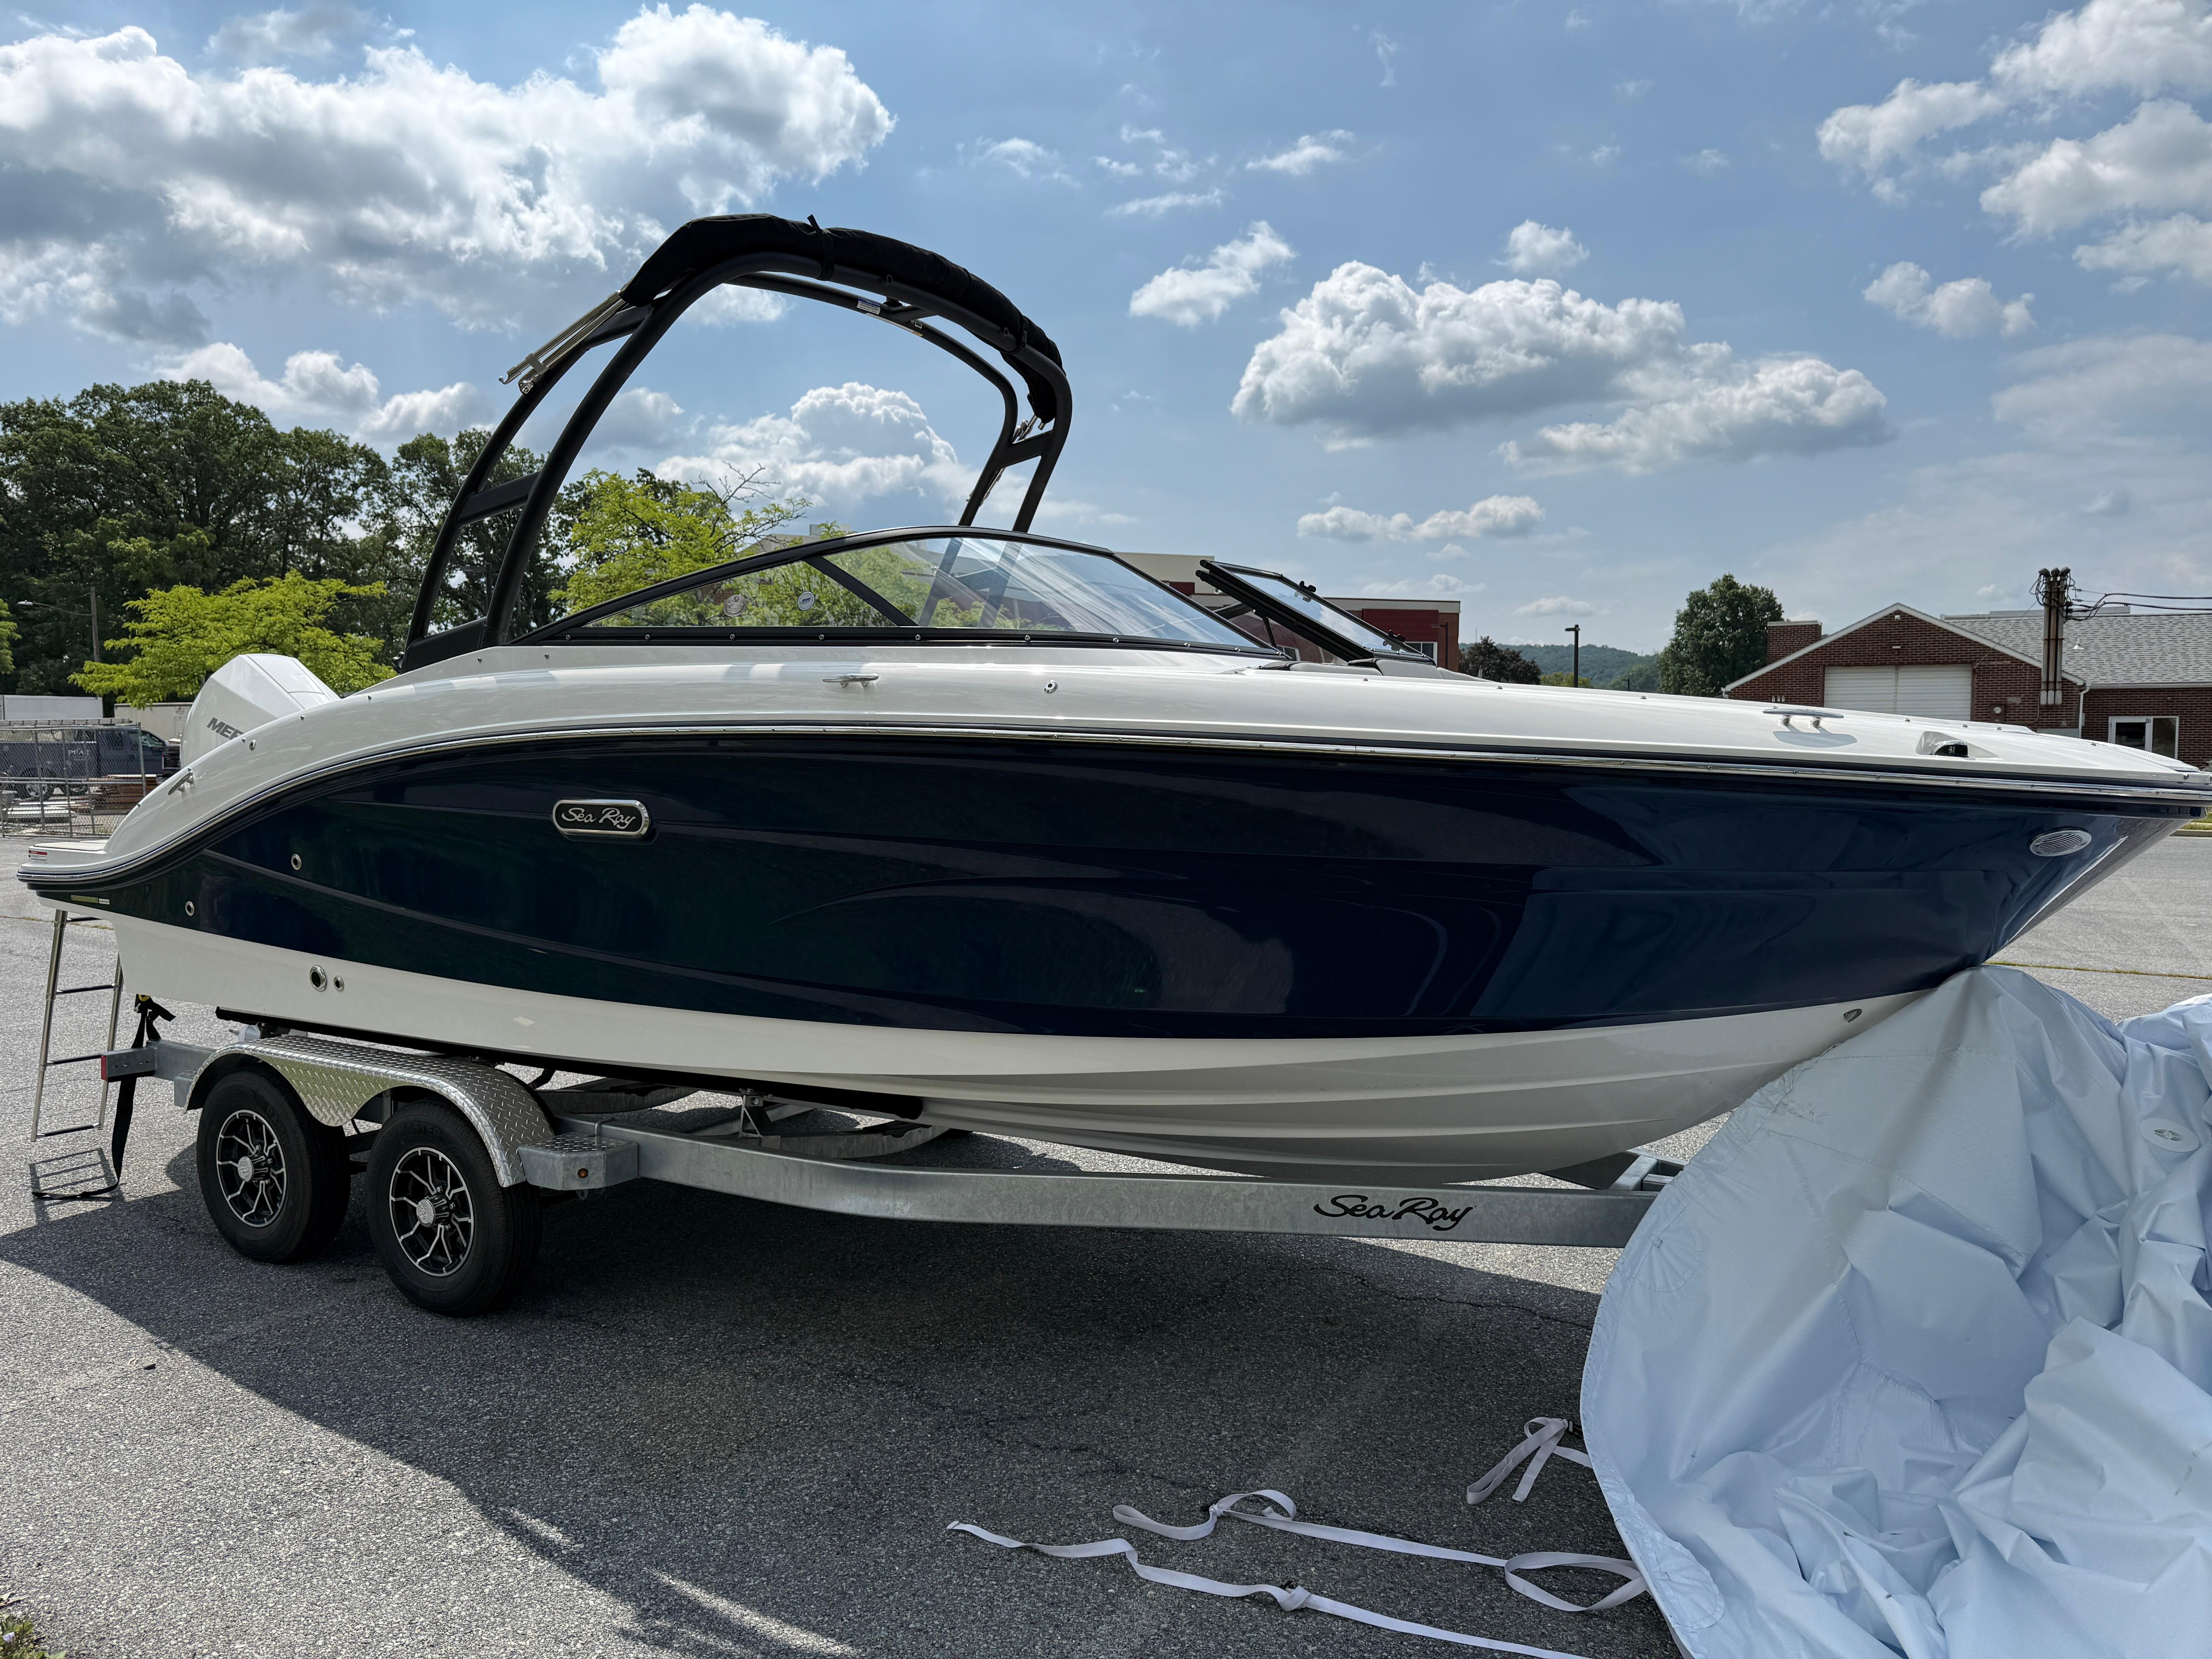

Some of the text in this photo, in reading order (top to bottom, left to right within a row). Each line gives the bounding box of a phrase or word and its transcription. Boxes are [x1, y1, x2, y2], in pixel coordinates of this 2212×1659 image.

[561, 807, 636, 829] Sea Ray
[1313, 1194, 1473, 1231] Sea Ray
